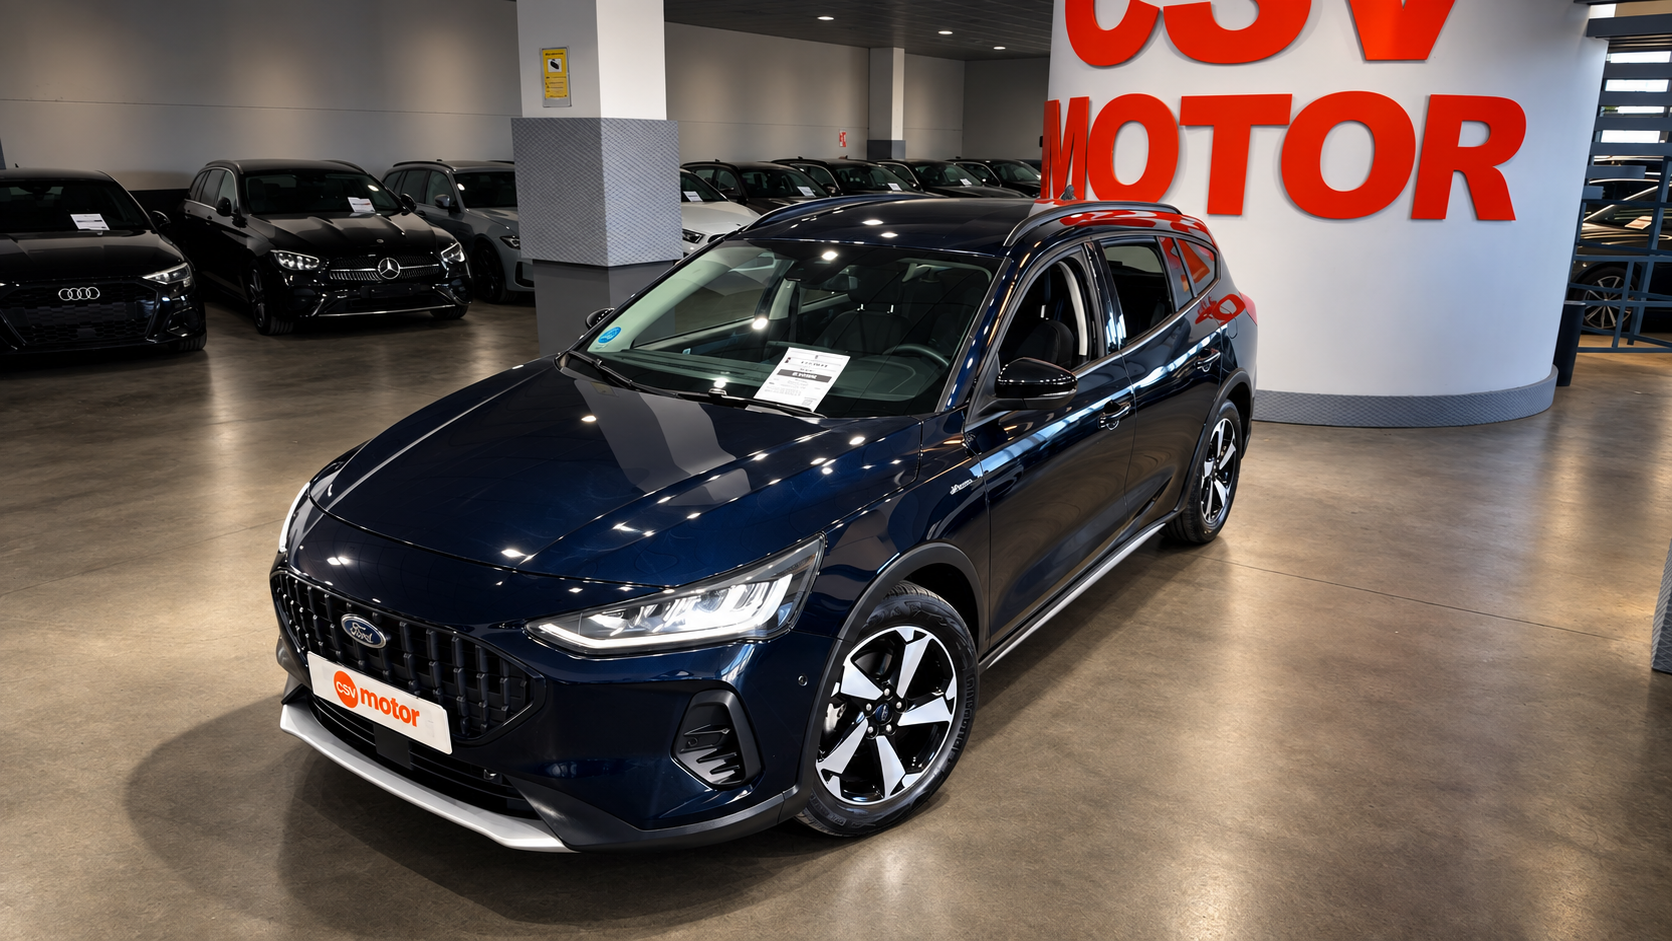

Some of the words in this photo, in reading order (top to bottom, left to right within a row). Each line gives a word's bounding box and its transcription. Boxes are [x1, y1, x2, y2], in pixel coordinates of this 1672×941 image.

[1041, 91, 1527, 221] MOTOR
[350, 621, 374, 644] Ford
[336, 681, 356, 699] CSV
[360, 687, 420, 727] motor
